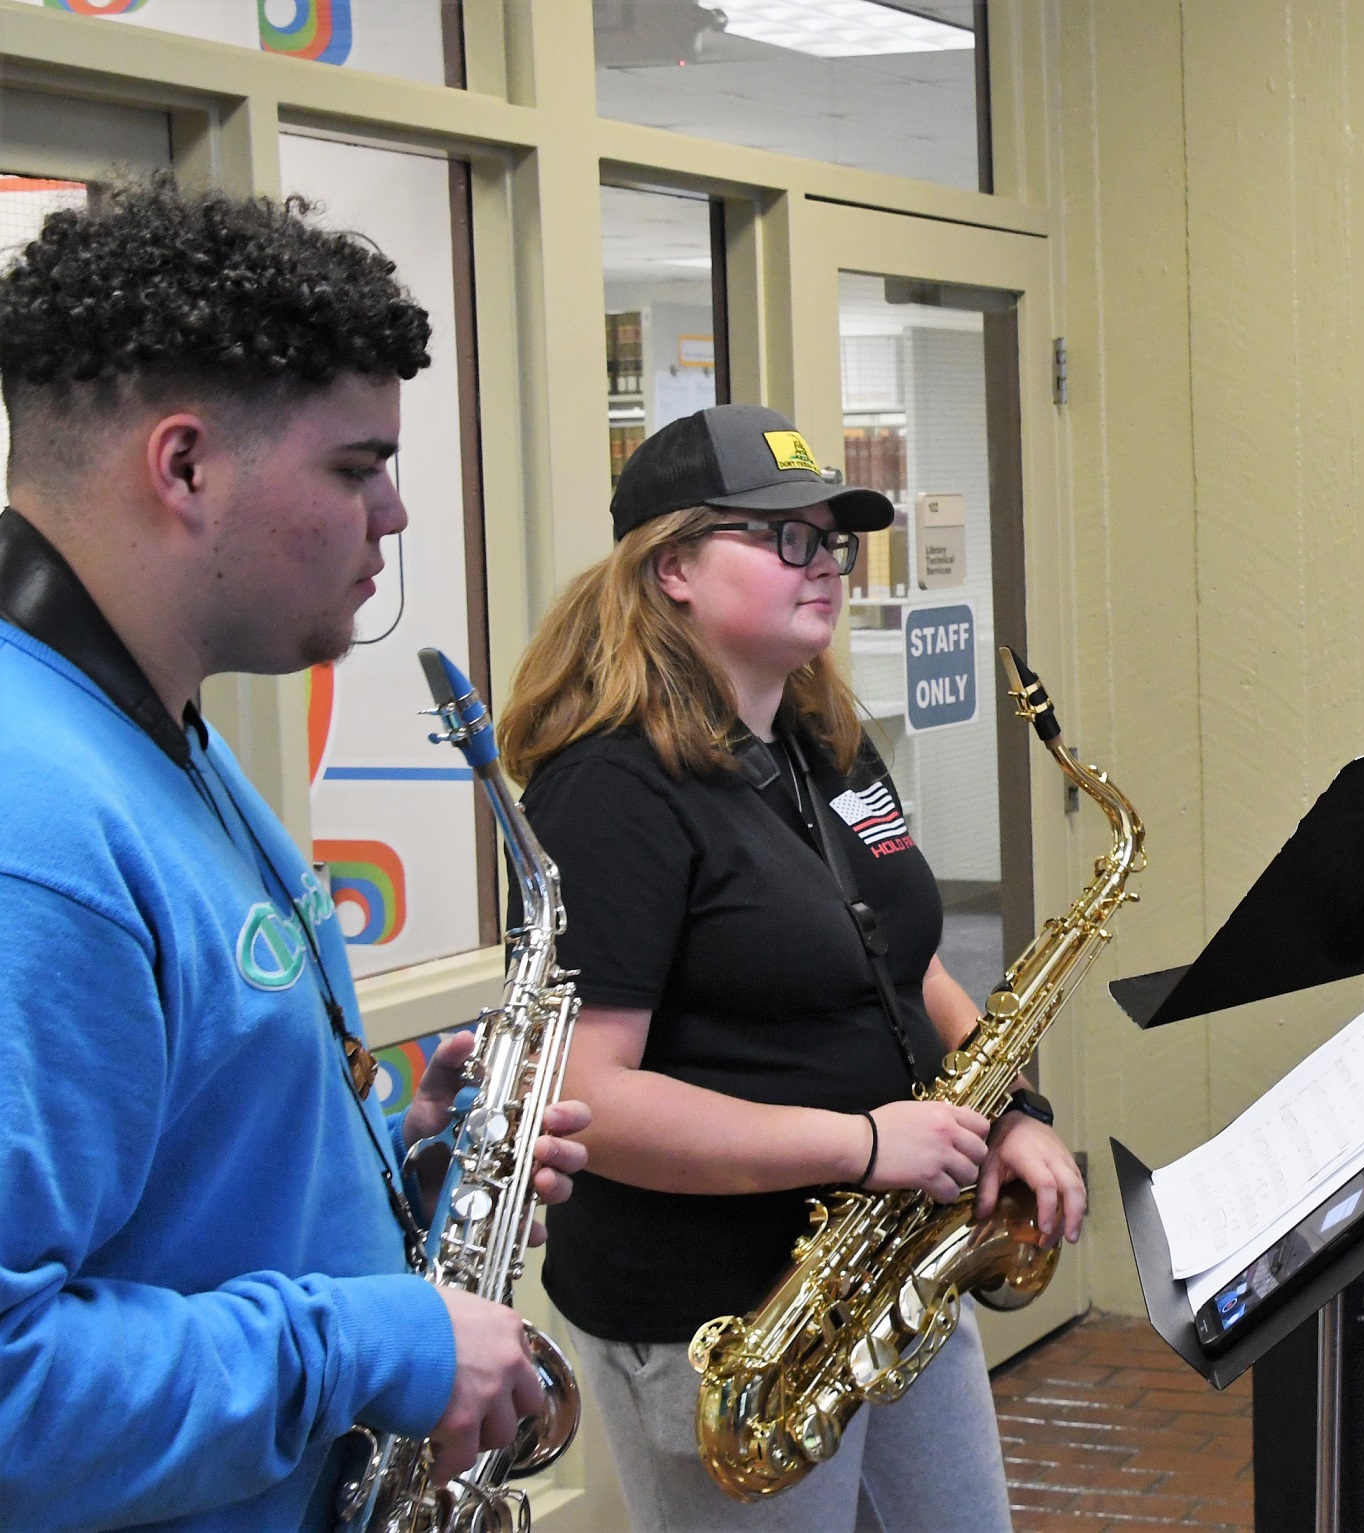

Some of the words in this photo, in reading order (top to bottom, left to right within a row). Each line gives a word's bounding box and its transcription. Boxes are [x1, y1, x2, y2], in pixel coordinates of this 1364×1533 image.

[926, 546, 947, 557] Library
[926, 555, 955, 565] Technical
[926, 567, 953, 575] Services
[910, 622, 970, 657] STAFF
[916, 674, 968, 709] ONLY
[871, 838, 906, 858] HOLD
